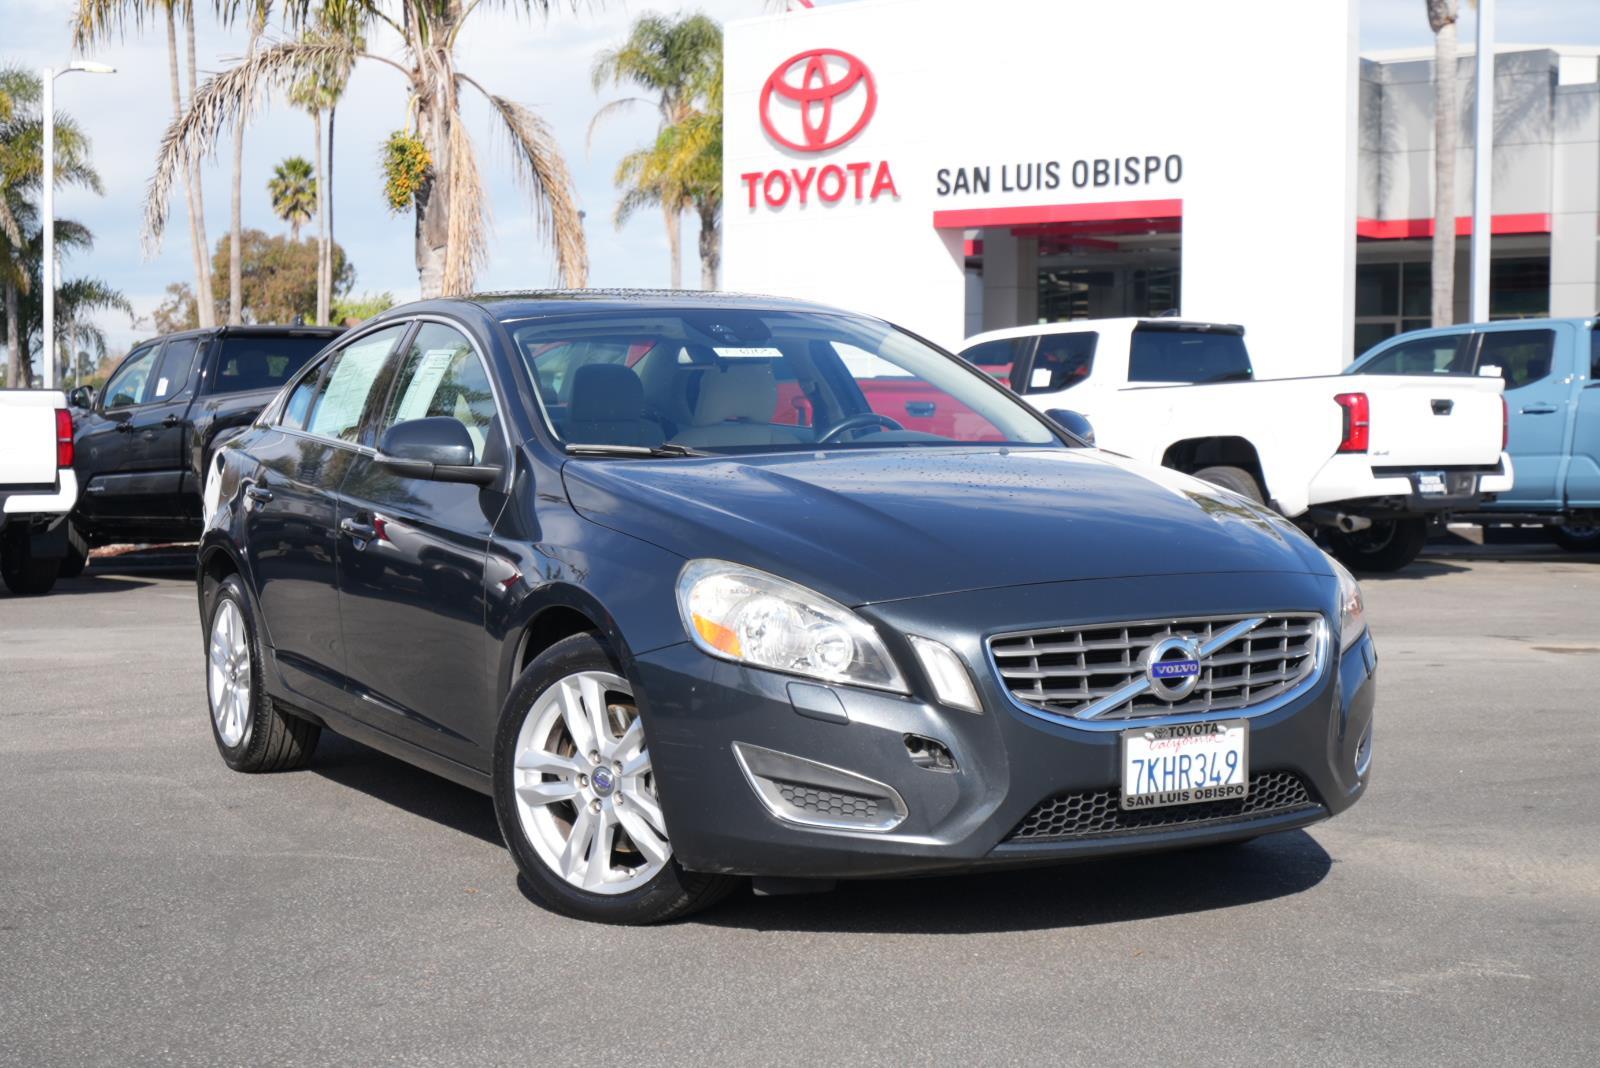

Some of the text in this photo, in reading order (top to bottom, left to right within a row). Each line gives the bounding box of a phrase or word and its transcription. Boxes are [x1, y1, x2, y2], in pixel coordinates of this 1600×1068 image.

[740, 160, 899, 208] TOYOTA
[936, 154, 1183, 196] SAN LUIS OBISPO
[1156, 663, 1198, 674] VOLVO
[1168, 723, 1218, 738] TOYOTA
[1132, 750, 1238, 795] 7KHR349
[1126, 785, 1244, 808] SAN LUIS OBISPO
